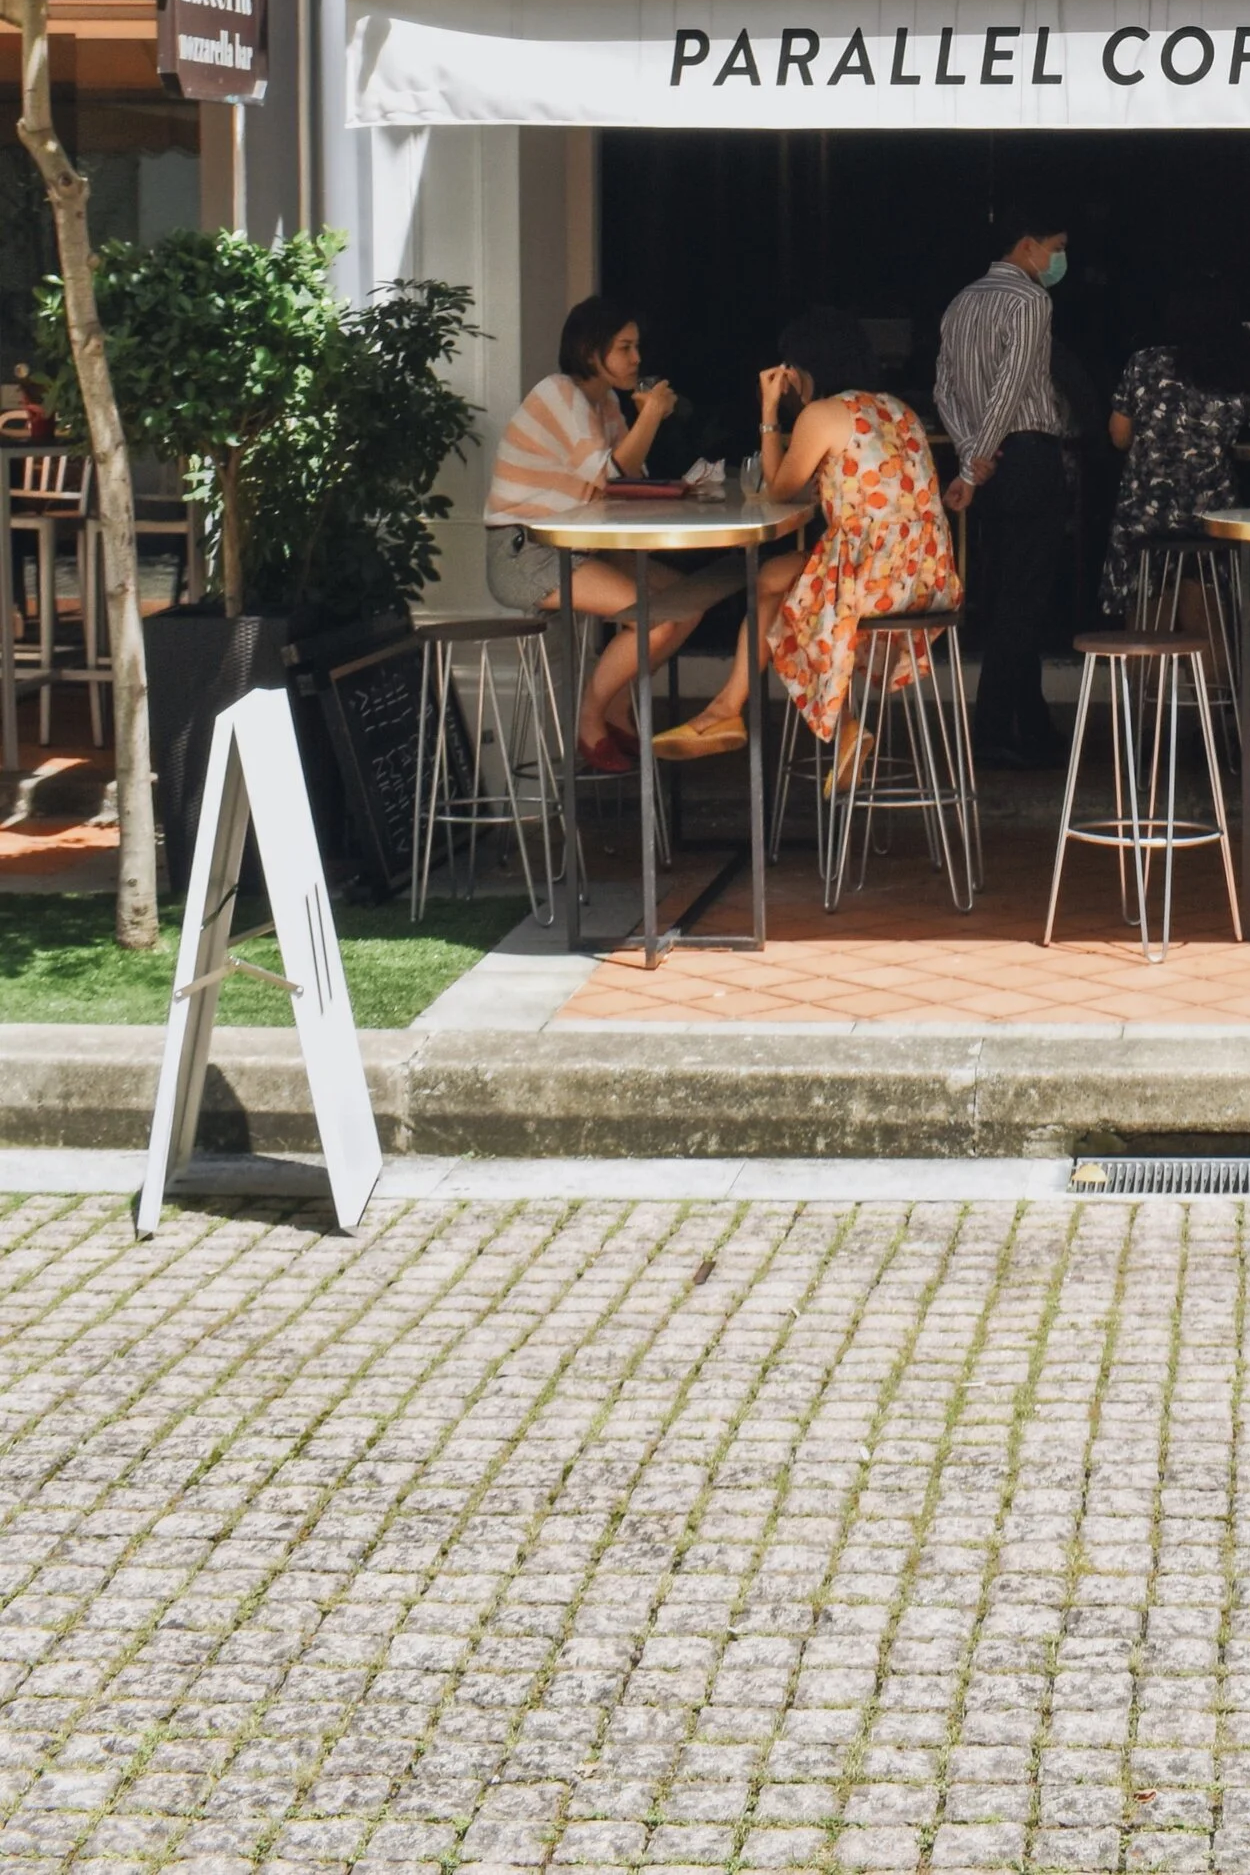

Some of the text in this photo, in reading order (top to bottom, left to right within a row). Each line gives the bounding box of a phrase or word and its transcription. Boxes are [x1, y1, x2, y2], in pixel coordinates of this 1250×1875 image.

[178, 29, 253, 71] mozzarella bar
[669, 27, 1062, 86] PARALLEL
